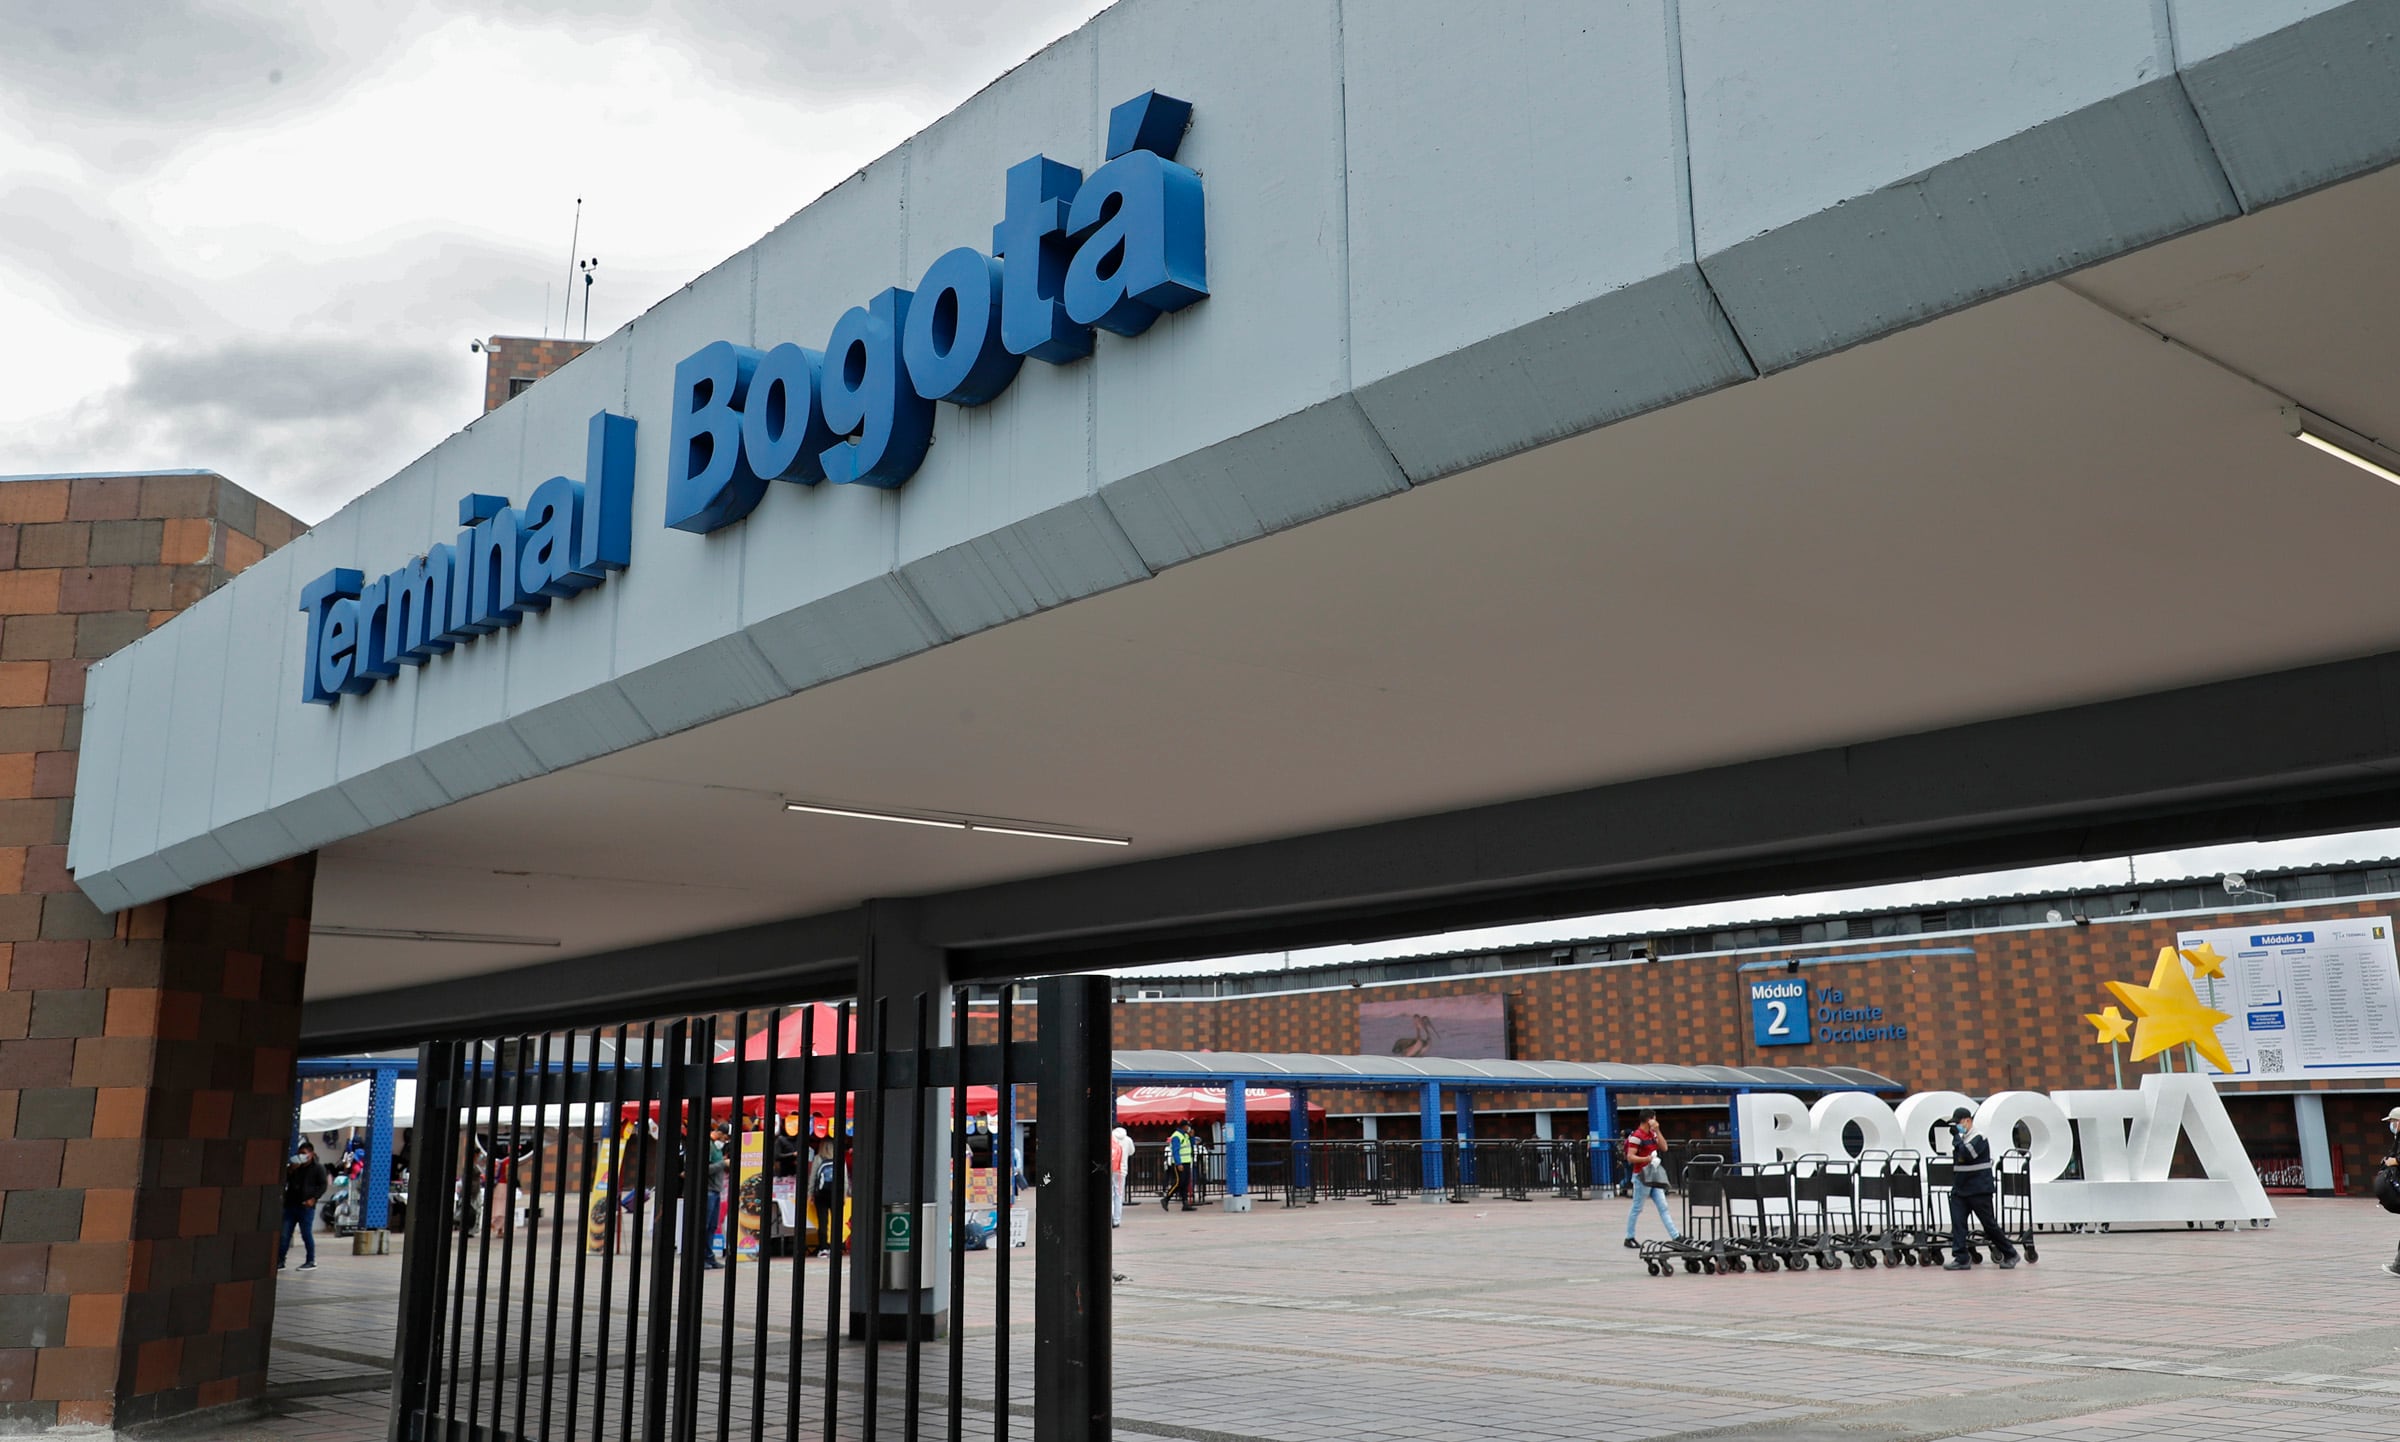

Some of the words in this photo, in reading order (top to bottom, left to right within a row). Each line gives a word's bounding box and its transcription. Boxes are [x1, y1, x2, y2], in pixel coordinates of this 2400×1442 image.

[301, 410, 637, 705] Terminal
[665, 89, 1209, 534] Bogotá
[2261, 934, 2295, 945] Módulo
[2296, 934, 2303, 942] 2
[1752, 983, 1803, 999] Módulo
[1816, 987, 1844, 1003] Vía
[1767, 1000, 1790, 1035] 2
[1817, 1005, 1883, 1023] Oriente
[1818, 1024, 1907, 1043] Occidente
